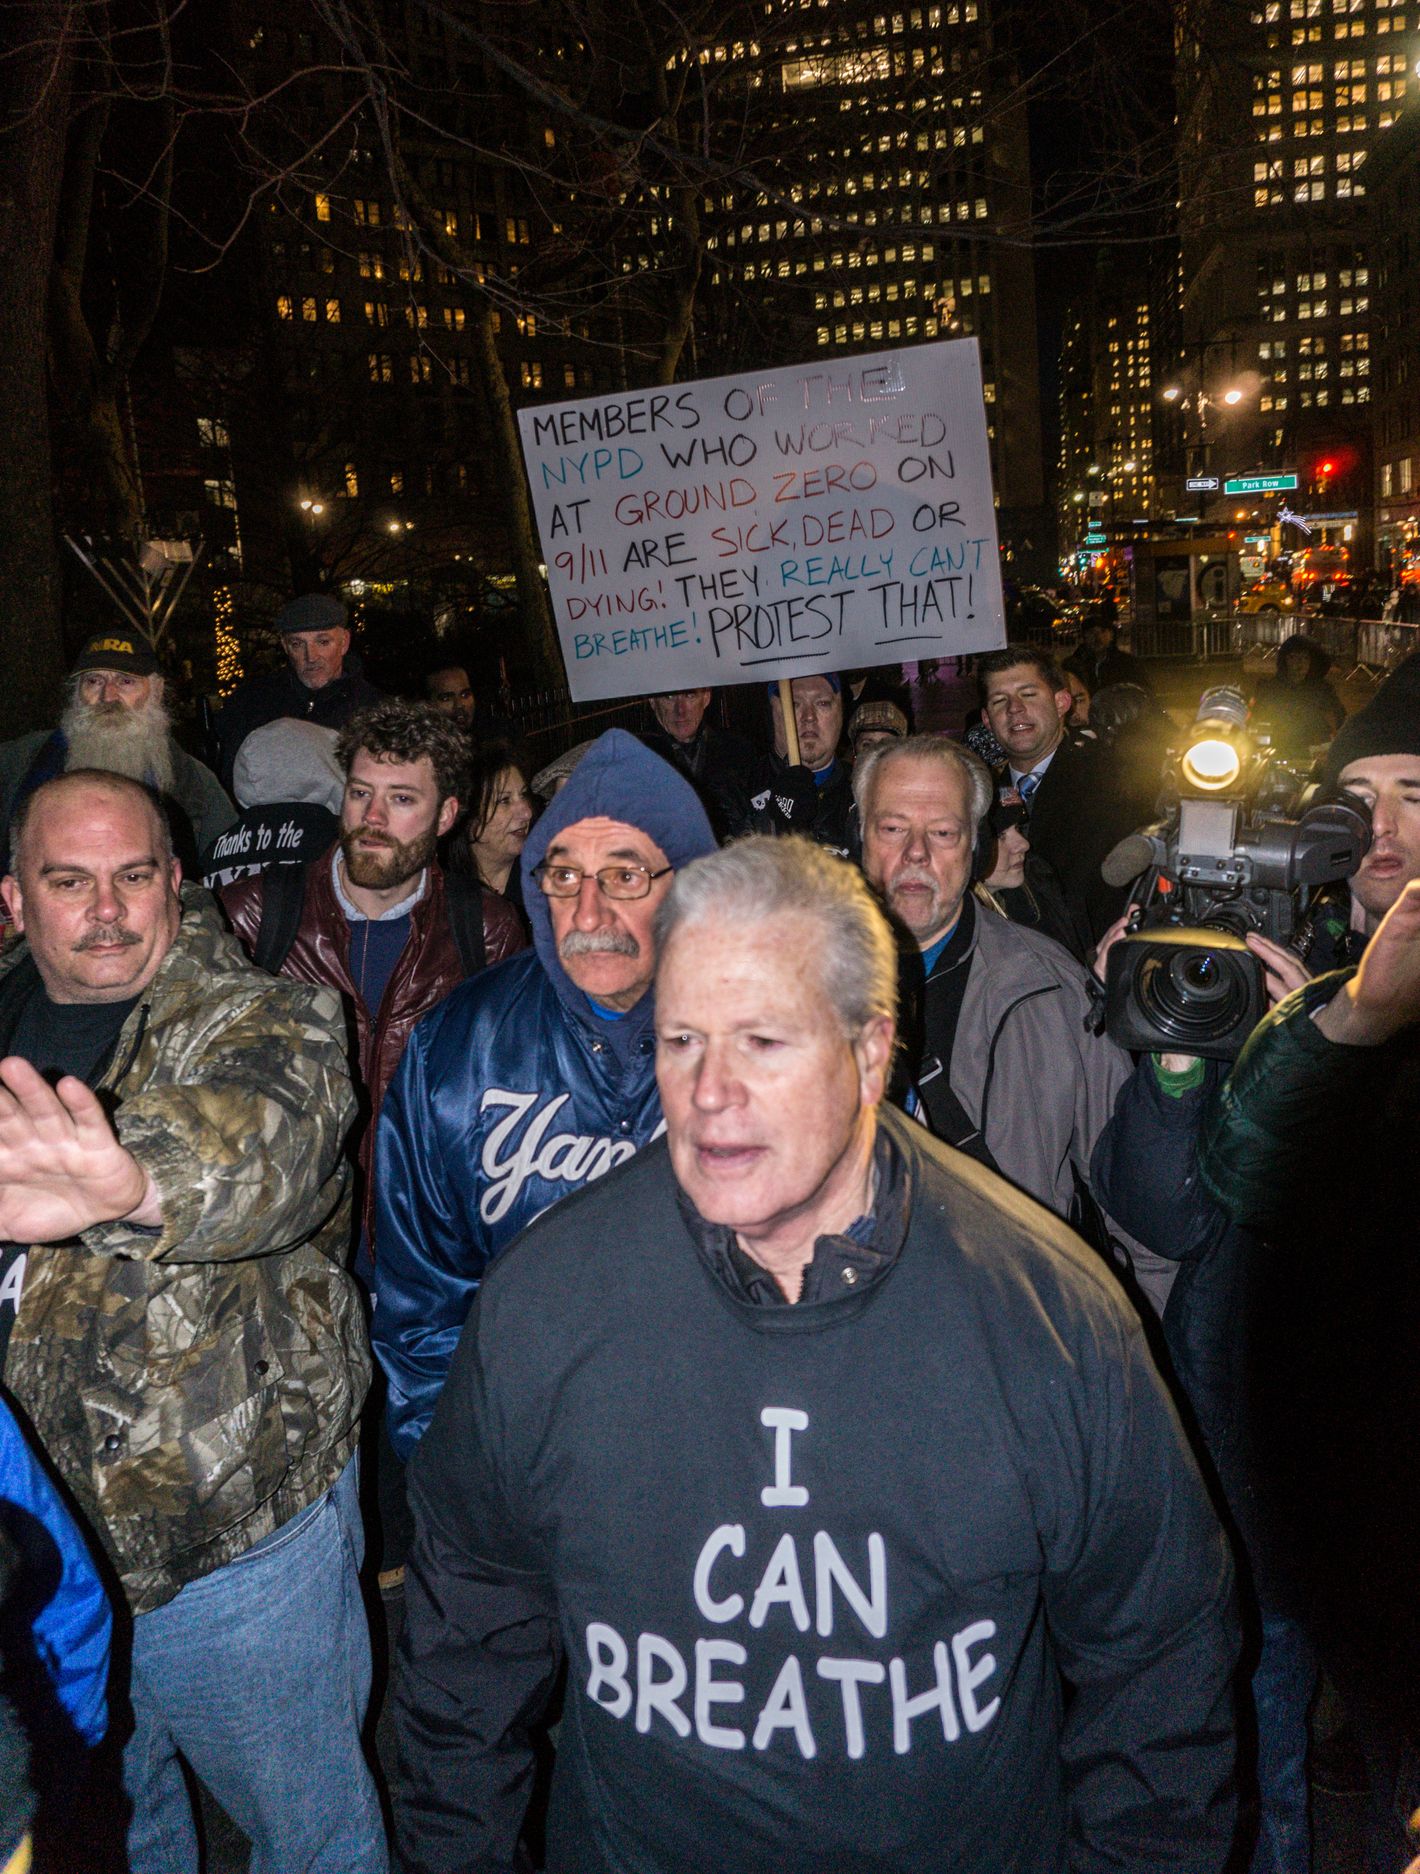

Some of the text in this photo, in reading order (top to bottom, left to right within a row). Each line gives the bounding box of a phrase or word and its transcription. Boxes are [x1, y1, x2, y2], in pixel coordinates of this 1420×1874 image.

[533, 367, 897, 446] MEMBERS OF THE
[541, 412, 946, 489] NYPD WHO WORKED
[550, 451, 954, 539] AT GROUND ZERO ON
[554, 543, 608, 585] 9/11
[623, 532, 697, 572] ARE
[912, 501, 966, 531] OR
[566, 538, 989, 620] DYING! THEY REALLY CAN'T
[574, 574, 975, 660] BREATHE! PROTEST THAT!
[213, 820, 304, 860] Thanks to the
[480, 1087, 668, 1226] Yan
[761, 1407, 809, 1507] I
[694, 1524, 887, 1639] CAN
[586, 1619, 1000, 1759] BREATHE
